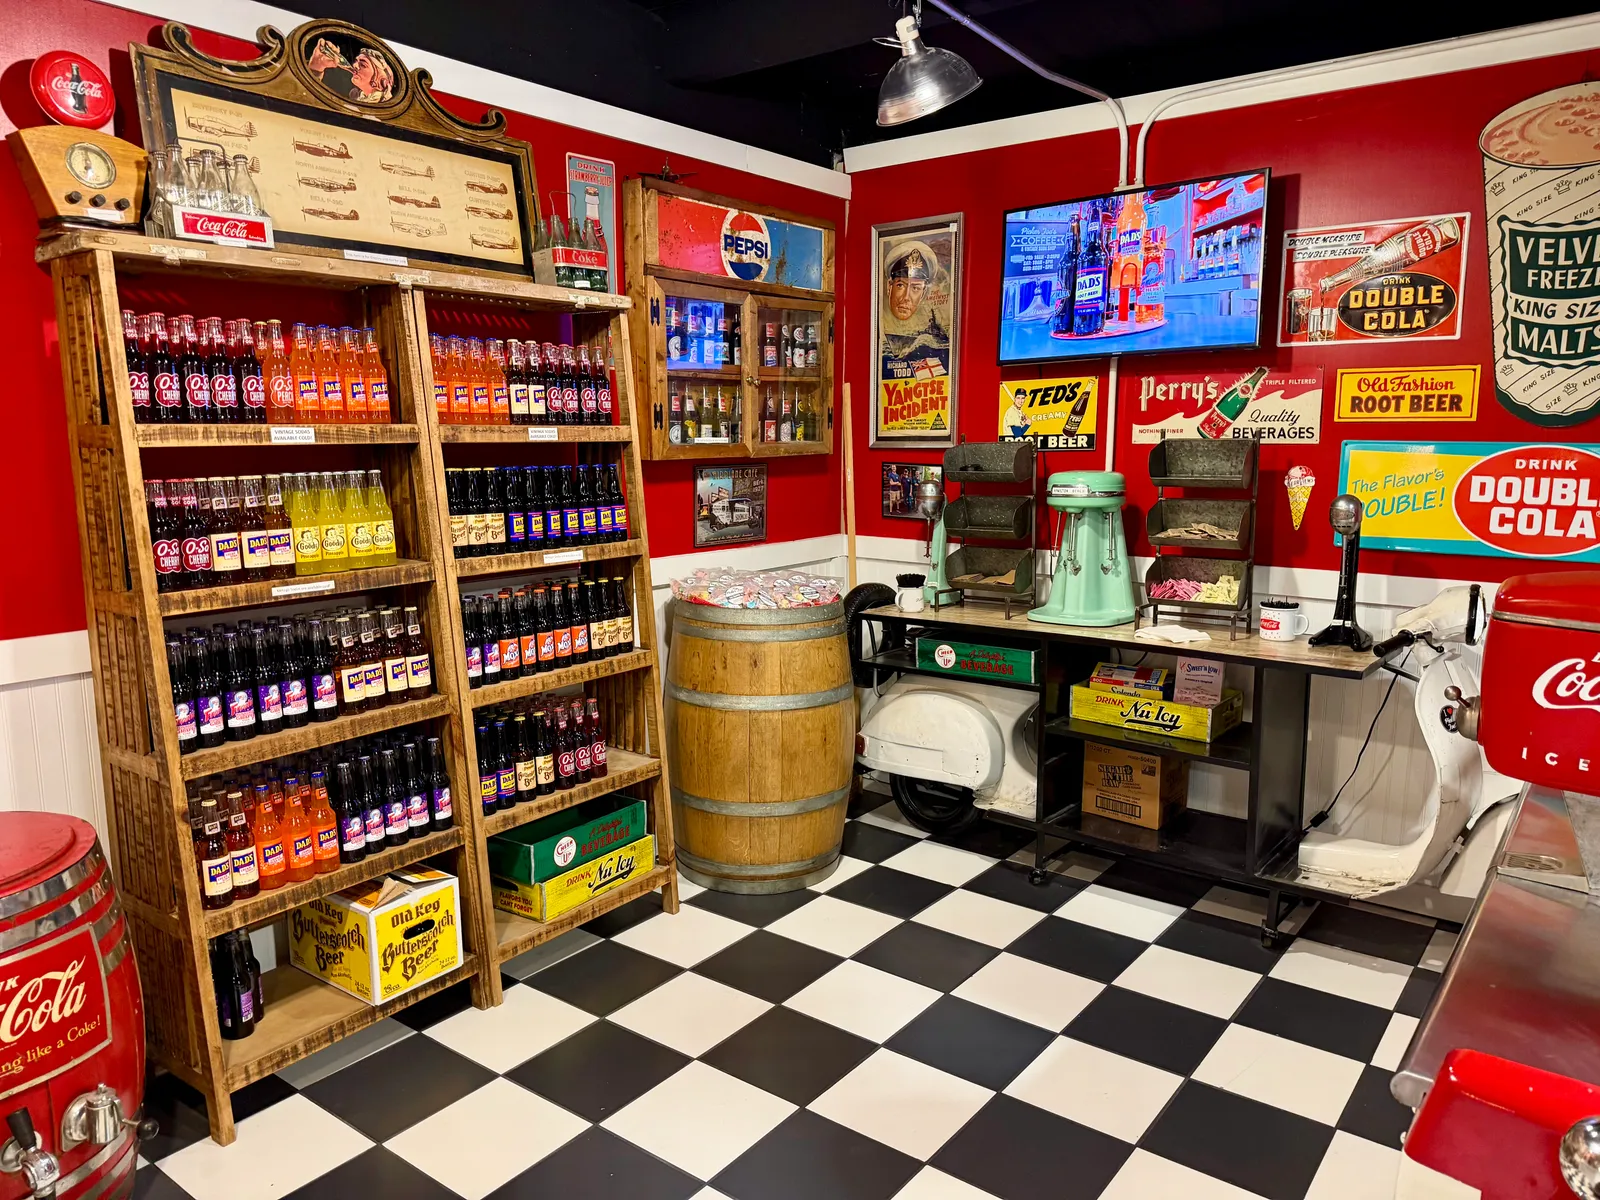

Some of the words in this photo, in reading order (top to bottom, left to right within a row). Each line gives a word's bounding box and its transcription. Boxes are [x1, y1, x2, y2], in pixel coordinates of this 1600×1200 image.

[51, 75, 103, 99] Coca-Cola
[577, 161, 605, 173] DRINK
[1512, 172, 1528, 184] KING
[1575, 173, 1595, 186] KING
[1516, 205, 1534, 217] KING
[1536, 194, 1552, 206] SIZE
[1574, 208, 1594, 220] KING
[196, 216, 248, 238] Coca-Cola
[1021, 237, 1056, 245] COFFEE
[1120, 231, 1140, 244] DAD'S
[1288, 236, 1322, 246] DOUBLE
[1322, 234, 1362, 244] MEASURE
[1412, 231, 1427, 258] DOUBLE
[1422, 230, 1433, 250] COLA
[724, 234, 768, 259] PEPSI
[1296, 249, 1328, 260] DOUBLE
[1329, 246, 1373, 257] PLEASURE
[572, 250, 598, 263] Coke
[1078, 276, 1100, 291] DAD'S
[1383, 277, 1411, 286] DRINK
[1350, 285, 1444, 309] DOUBLE
[1513, 298, 1557, 319] KING
[1364, 309, 1425, 331] COLA
[894, 368, 912, 378] TODD
[1522, 380, 1537, 393] KING
[1540, 368, 1556, 381] SIZE
[1357, 377, 1389, 392] Old
[1390, 375, 1455, 391] Fashion
[883, 380, 944, 406] YANGTSE
[1028, 382, 1082, 408] TED'S
[1139, 376, 1220, 412] Perry's
[884, 396, 948, 425] INCIDENT
[1350, 395, 1407, 413] ROOT
[1409, 394, 1463, 412] BEER
[1546, 396, 1562, 410] SIZE
[1032, 412, 1067, 422] CREAMY
[1248, 409, 1300, 426] Quality
[1048, 436, 1088, 448] BEER
[1232, 427, 1315, 440] BEVERAGES
[1515, 459, 1577, 470] DRINK
[1352, 480, 1378, 494] The
[1383, 468, 1445, 489] Flavor's
[1489, 507, 1596, 539] COLA
[961, 660, 1014, 675] BEVERAGE
[1095, 696, 1125, 708] DRINK
[1120, 701, 1152, 717] Nu
[1154, 705, 1183, 728] Icy
[1098, 764, 1126, 774] SUGAR
[1102, 772, 1113, 780] IN
[1114, 774, 1133, 782] THE
[1102, 779, 1120, 788] RAW
[556, 840, 574, 856] CHEER
[581, 826, 630, 857] BEVERAGE
[561, 852, 572, 863] UP
[566, 870, 592, 887] DRINK
[588, 855, 614, 889] Nu
[615, 854, 637, 872] Icy
[500, 892, 521, 903] FLAVORS
[522, 898, 532, 906] YOU
[325, 905, 344, 924] Keg
[391, 909, 413, 928] Old
[415, 898, 441, 920] Keg
[514, 903, 533, 913] FORGET
[292, 909, 366, 954] Butterscotch
[382, 909, 454, 974] Butterscotch
[314, 944, 344, 972] Beer
[401, 939, 440, 982] Beer
[26, 1045, 52, 1062] like
[57, 1040, 65, 1048] a
[67, 1014, 101, 1042] Coke!
